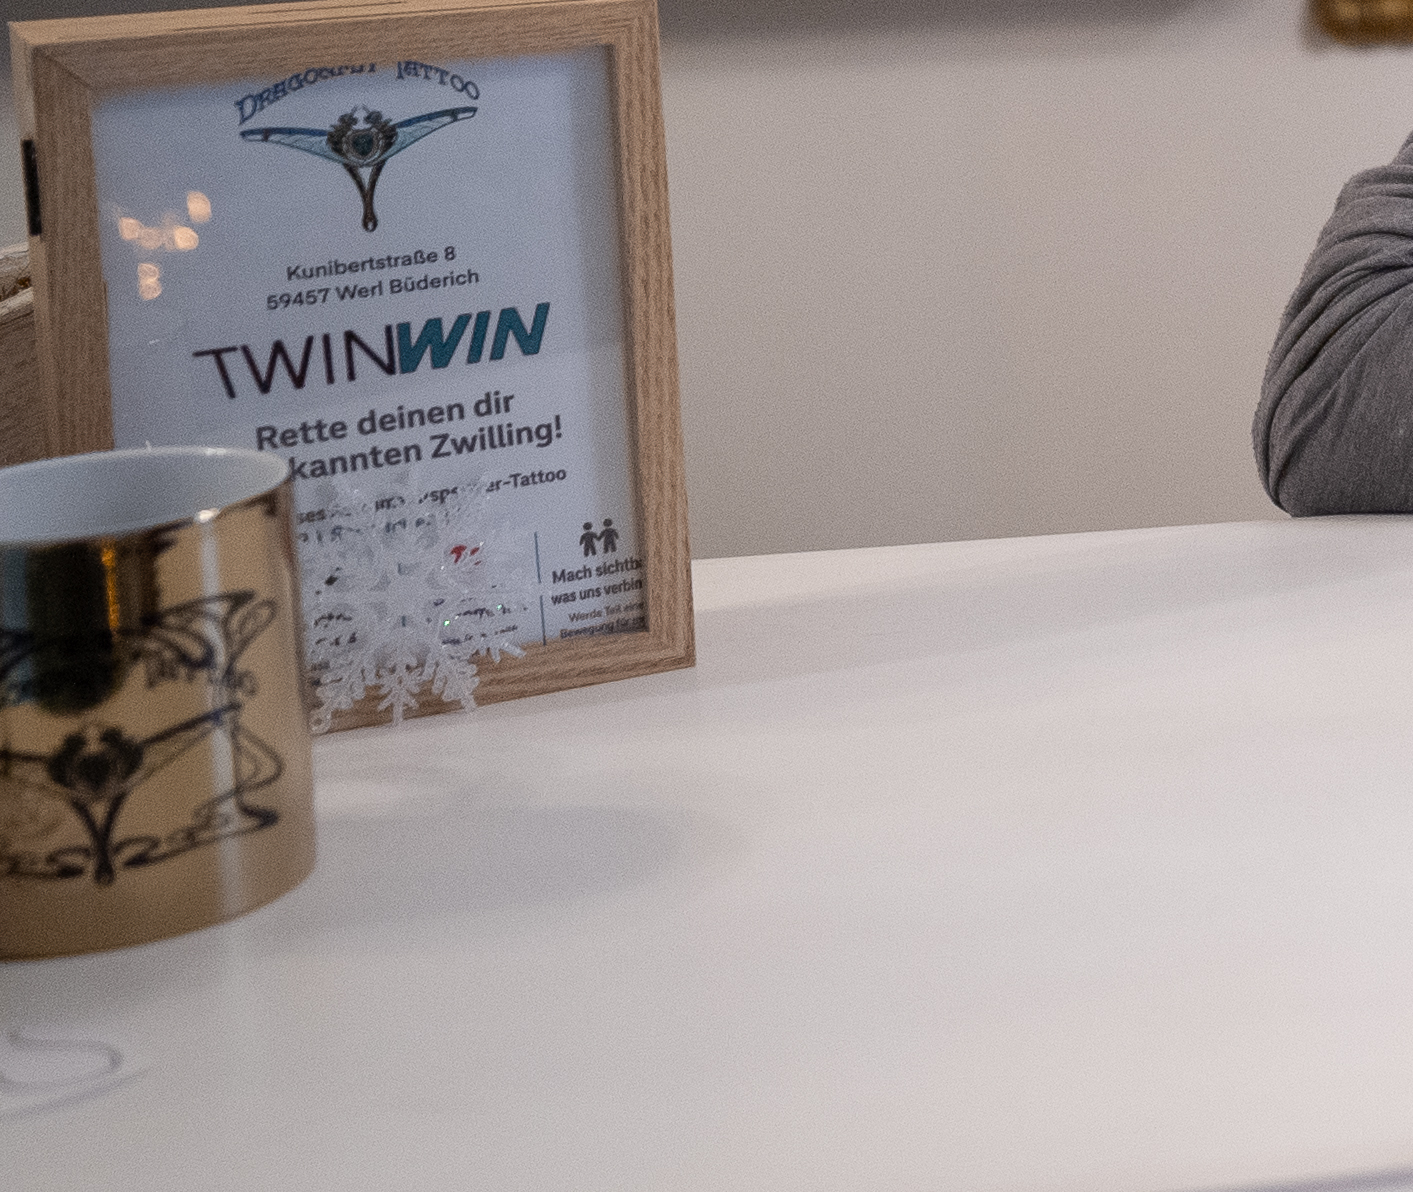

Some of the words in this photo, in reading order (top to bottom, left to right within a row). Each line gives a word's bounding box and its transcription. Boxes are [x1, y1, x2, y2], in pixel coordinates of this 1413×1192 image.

[286, 249, 439, 281] Kunibertstraße
[443, 245, 457, 261] 8
[266, 287, 331, 310] 59457
[335, 280, 384, 302] Werl
[389, 268, 480, 295] Büderich
[192, 301, 551, 400] TWINWIN
[255, 415, 349, 452] Rette
[356, 405, 466, 437] deinen
[473, 389, 515, 418] dir
[288, 443, 423, 482] kannten
[430, 413, 563, 460] Zwilling!
[552, 565, 592, 584] Mach
[551, 591, 577, 606] was
[579, 586, 601, 600] uns
